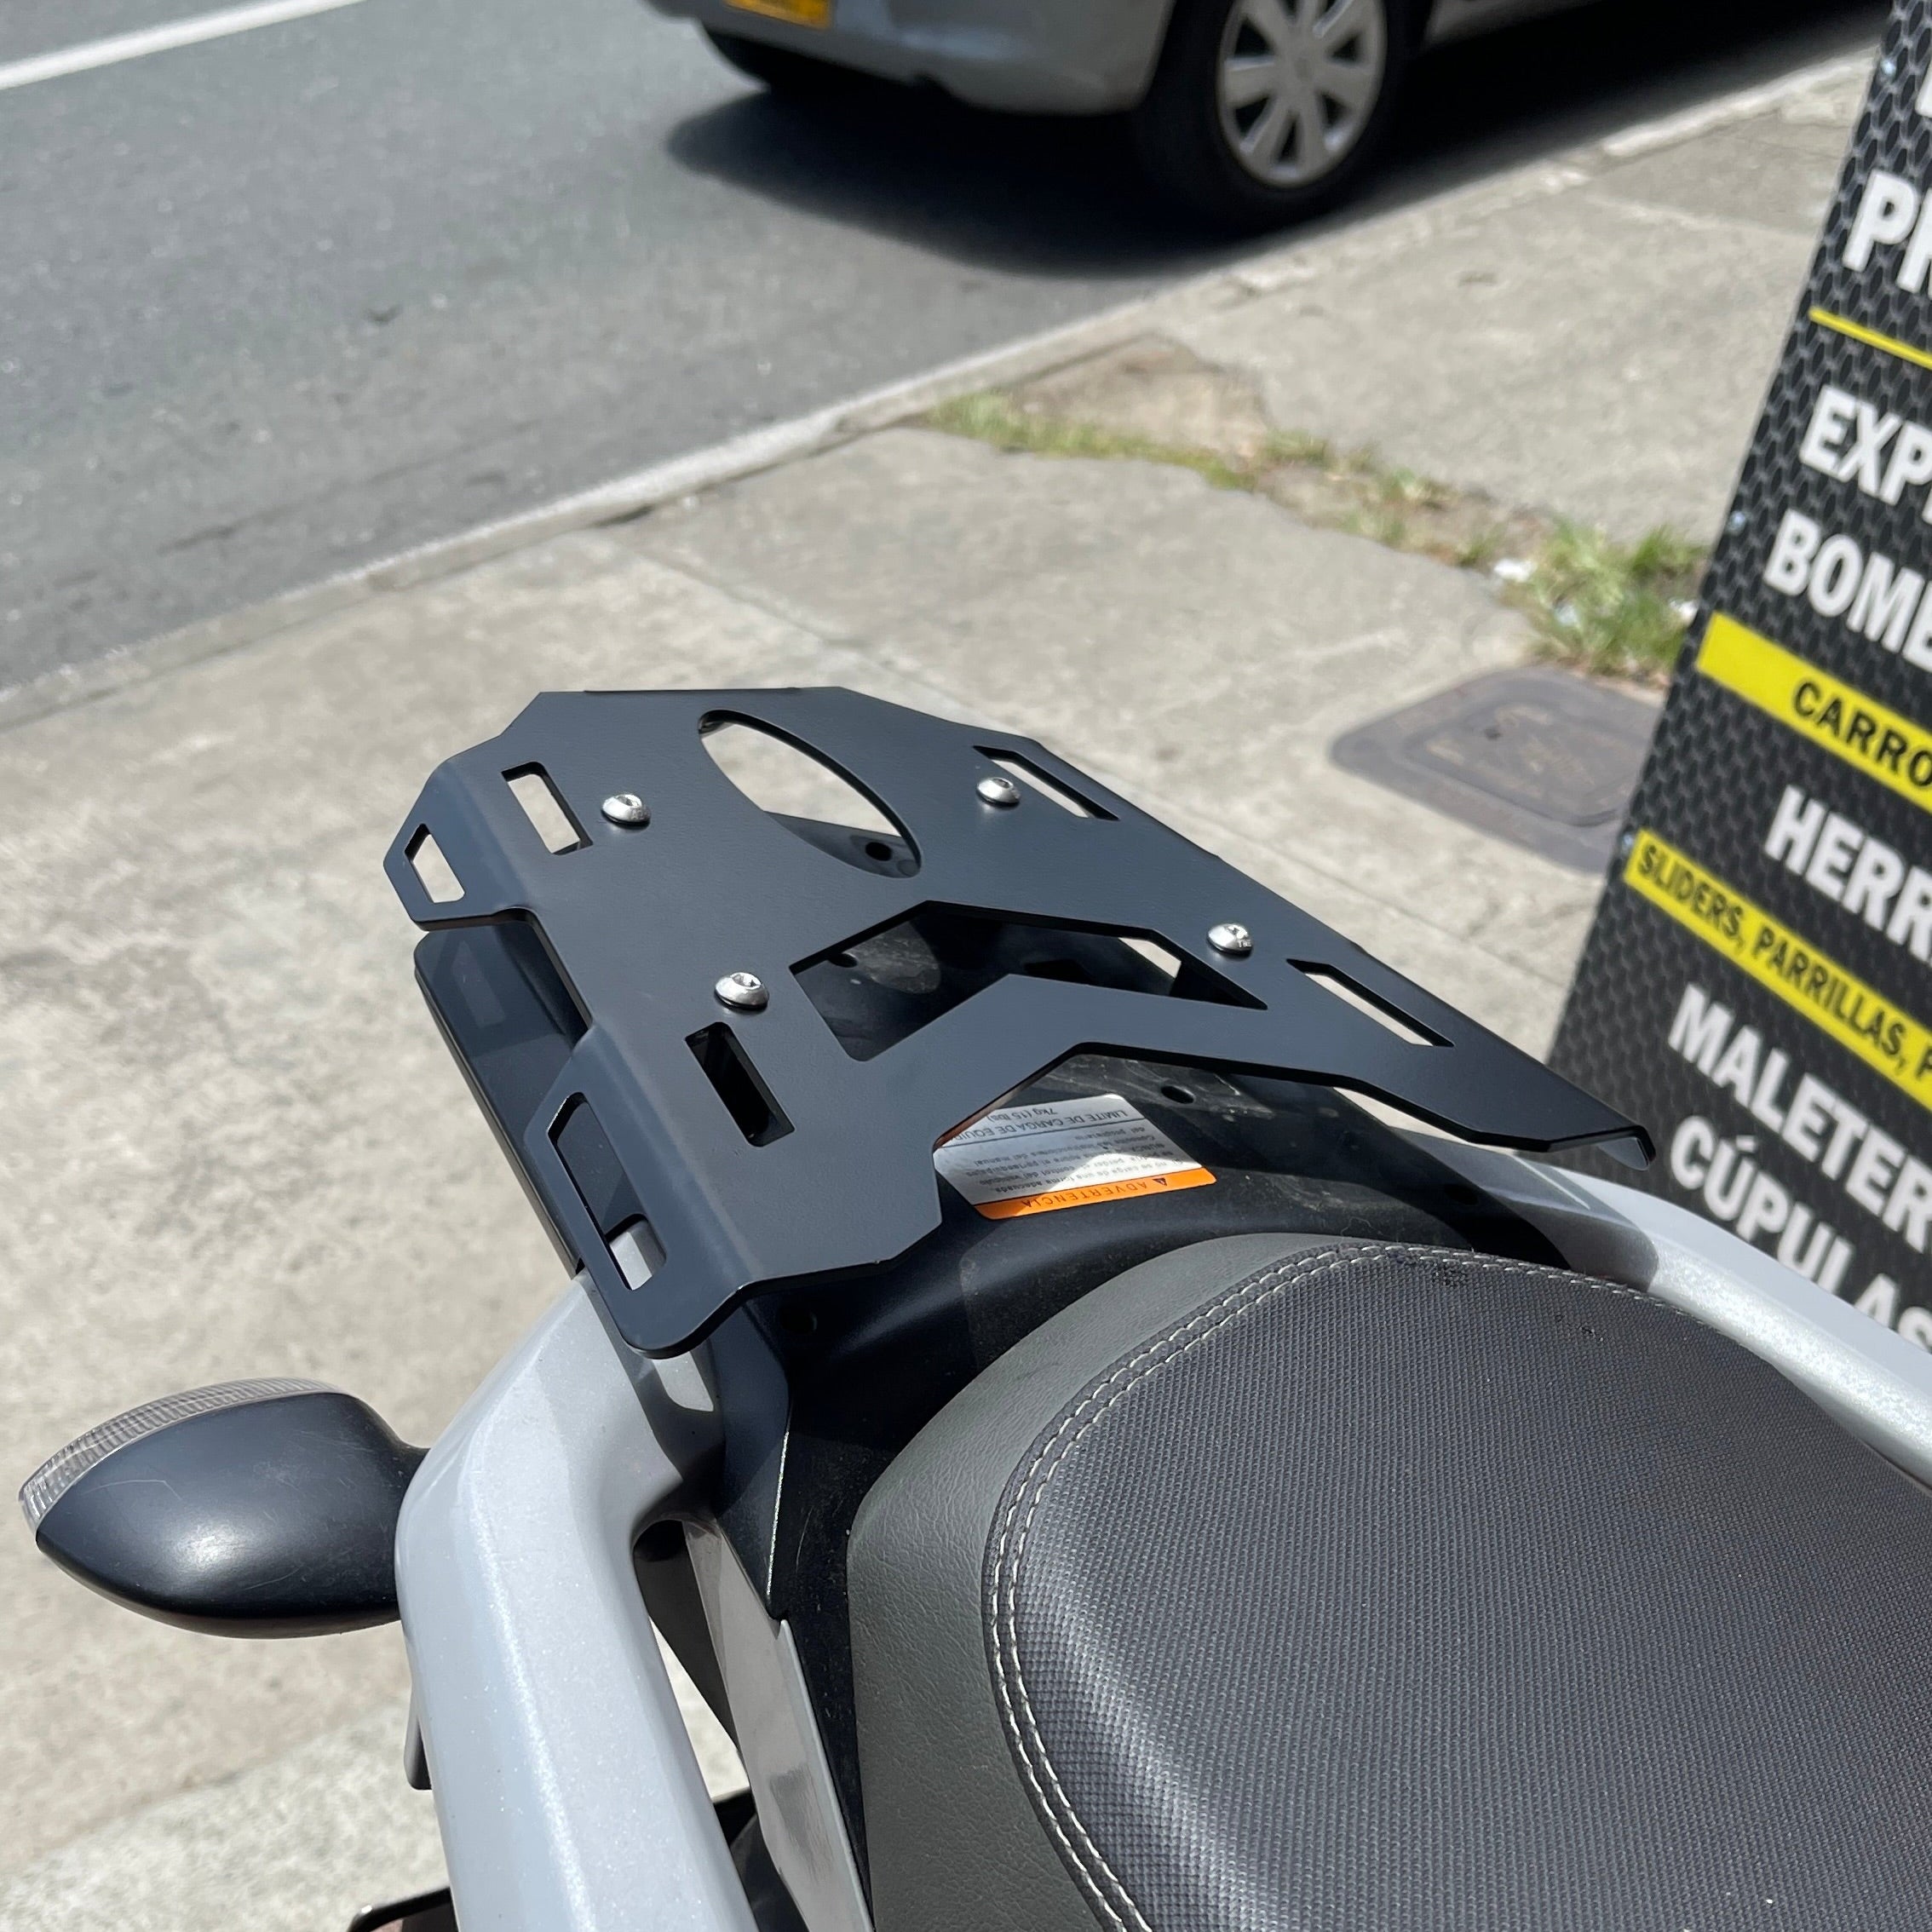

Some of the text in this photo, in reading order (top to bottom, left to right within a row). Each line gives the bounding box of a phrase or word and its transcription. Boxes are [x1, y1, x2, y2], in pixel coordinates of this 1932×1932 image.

[1798, 384, 1932, 526] EXP
[1794, 681, 1932, 787] CARRO
[1763, 783, 1932, 968] HERR
[1637, 845, 1906, 1077] SLIDERS, PARRILLAS,
[952, 1109, 1130, 1140] LIMITE DE CARGA DE EQUIP
[984, 1107, 1058, 1123] 7kg (15 lbs)
[1667, 983, 1932, 1256] MALETER
[1020, 1180, 1149, 1208] ADVERTENCIA
